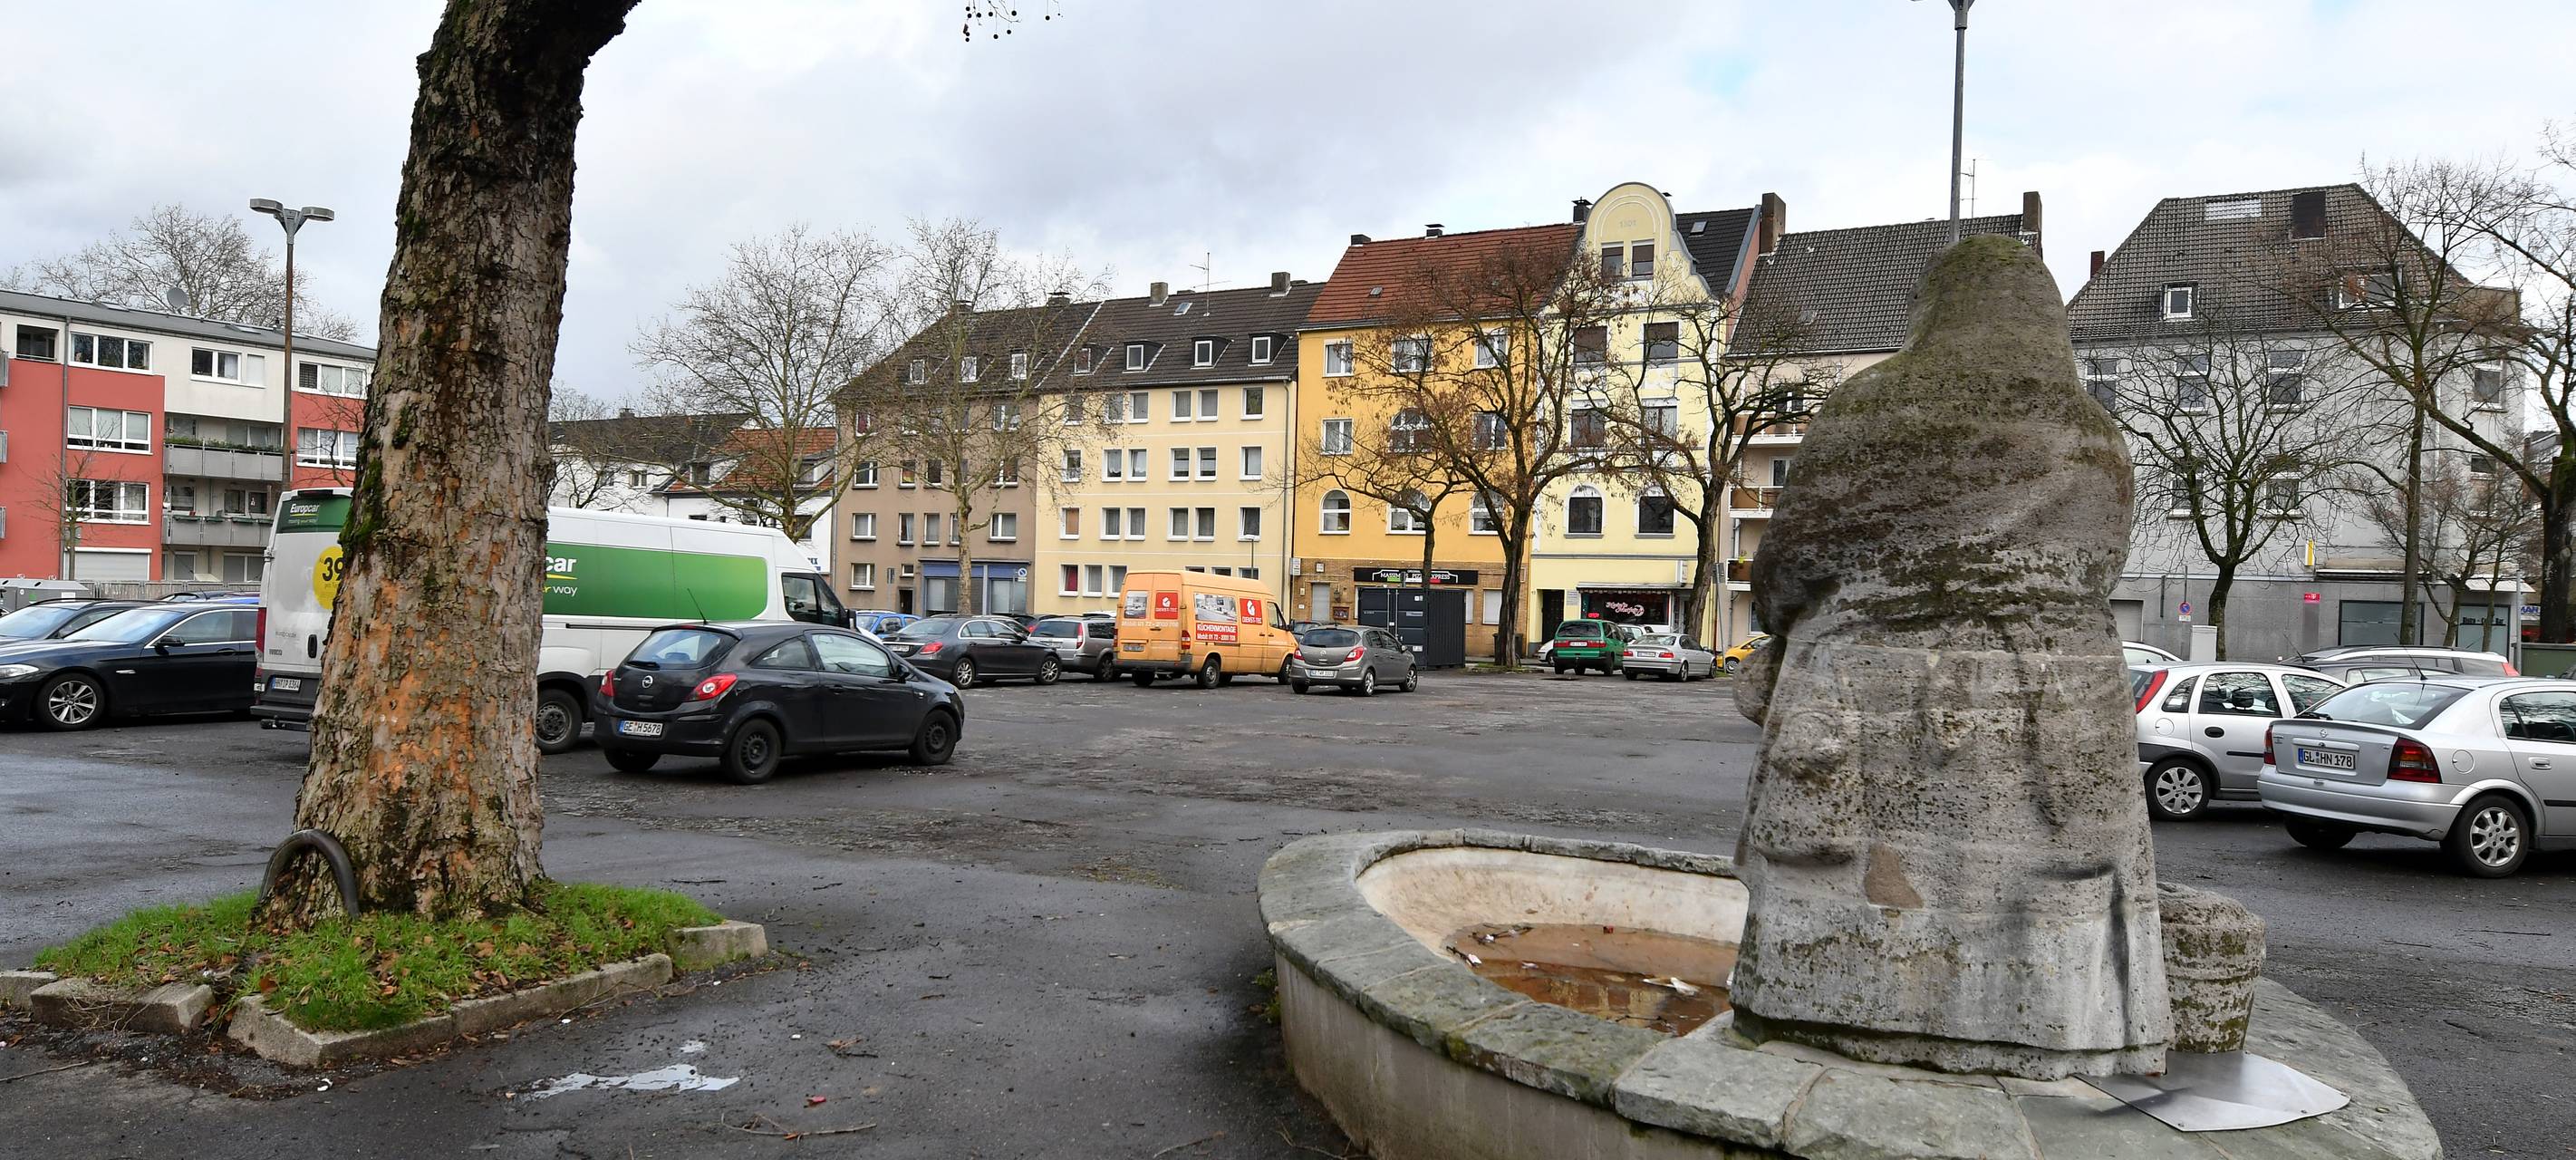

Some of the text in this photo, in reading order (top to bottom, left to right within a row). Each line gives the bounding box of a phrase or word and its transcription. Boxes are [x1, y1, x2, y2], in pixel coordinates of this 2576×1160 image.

[290, 504, 320, 515] Europcar
[323, 556, 345, 581] 39
[553, 586, 577, 597] way
[1242, 616, 1262, 624] DIENST-TEC
[623, 721, 634, 731] GE
[643, 723, 661, 733] 5678
[2303, 751, 2314, 762] GL
[2320, 753, 2332, 764] HN
